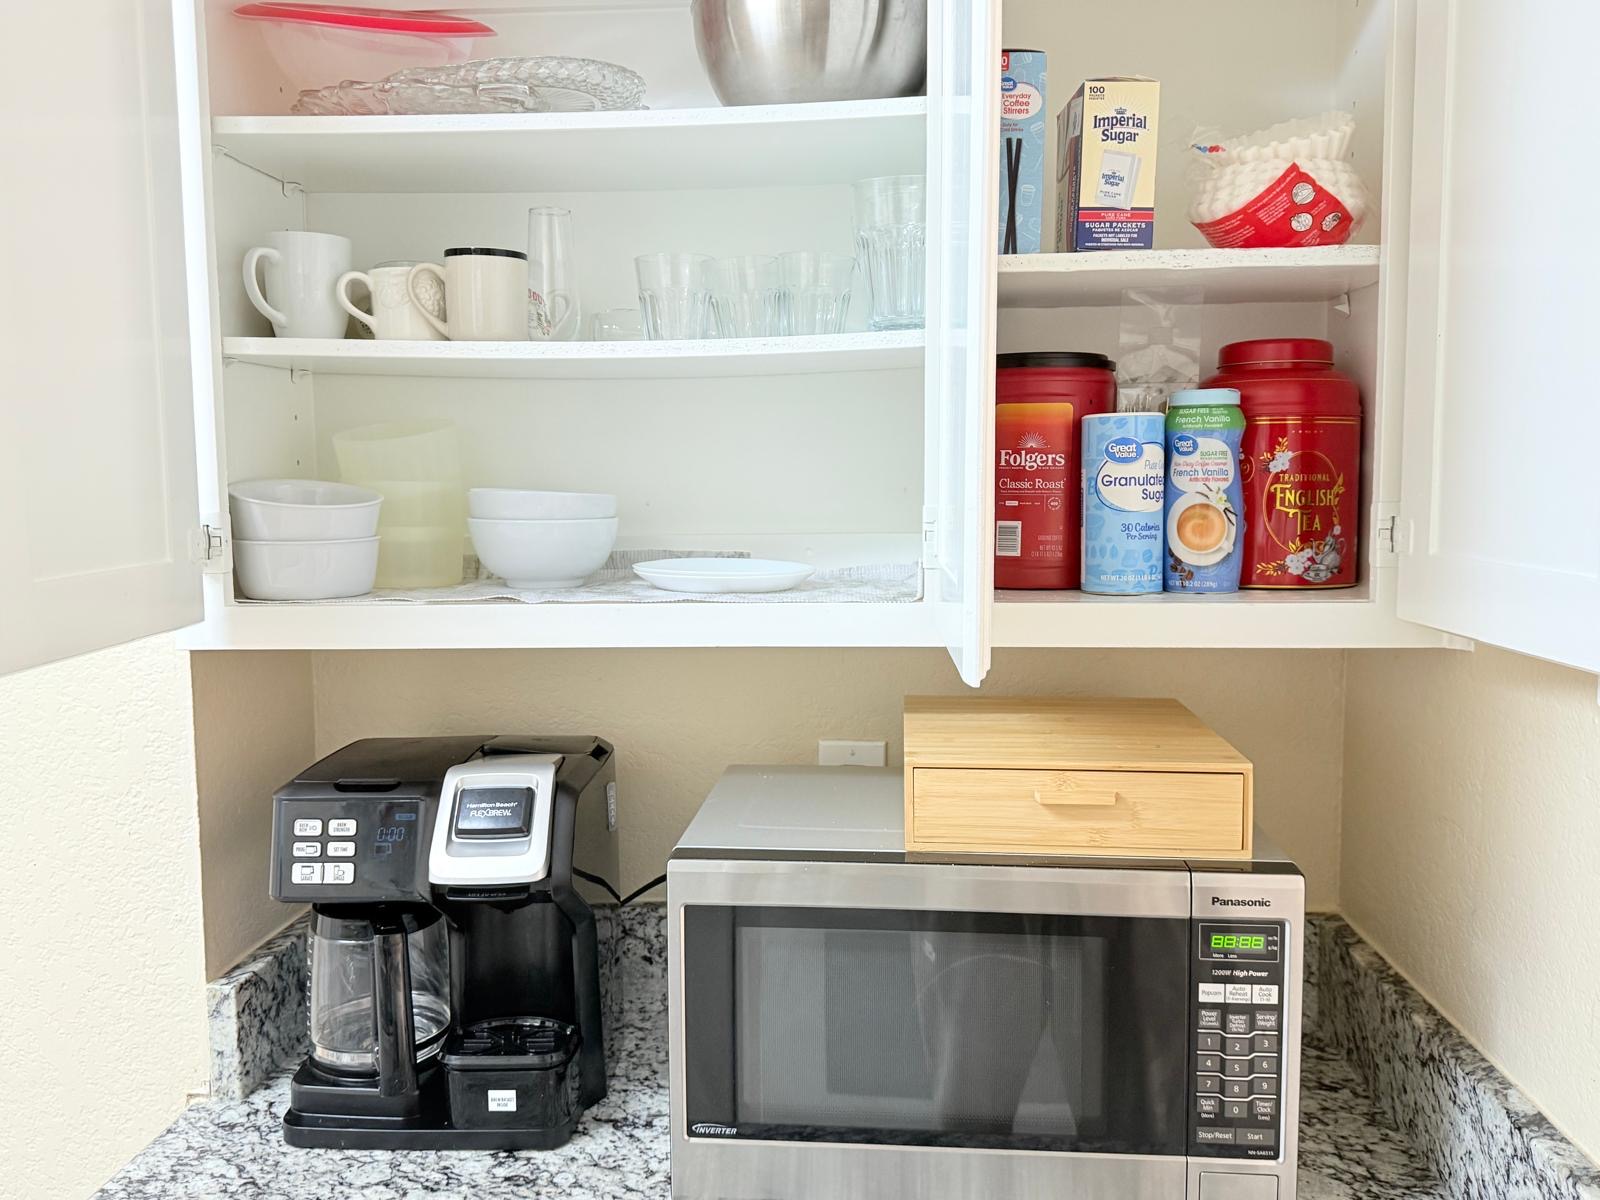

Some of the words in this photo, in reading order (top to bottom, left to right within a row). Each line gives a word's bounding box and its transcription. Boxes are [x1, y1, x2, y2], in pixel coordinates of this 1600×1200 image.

[1093, 113, 1147, 130] Imperial
[1101, 129, 1139, 144] Sugar
[1102, 172, 1125, 182] Imperial
[1108, 443, 1136, 453] Great
[1174, 440, 1193, 448] Great
[999, 450, 1065, 470] Folgers
[1173, 468, 1199, 477] French
[1201, 468, 1228, 476] Vanilla
[999, 478, 1033, 488] Classic
[1035, 478, 1064, 488] Roast
[1101, 474, 1164, 486] Granulate
[1279, 474, 1330, 482] TRADITIONAL
[1270, 484, 1334, 509] ENGLISH
[1121, 523, 1133, 532] 30
[1135, 522, 1160, 532] Calories
[1288, 509, 1321, 535] TEA
[470, 808, 512, 817] FLEXBREW
[1212, 897, 1271, 907] Panasonic
[696, 1126, 737, 1134] INVERTER
